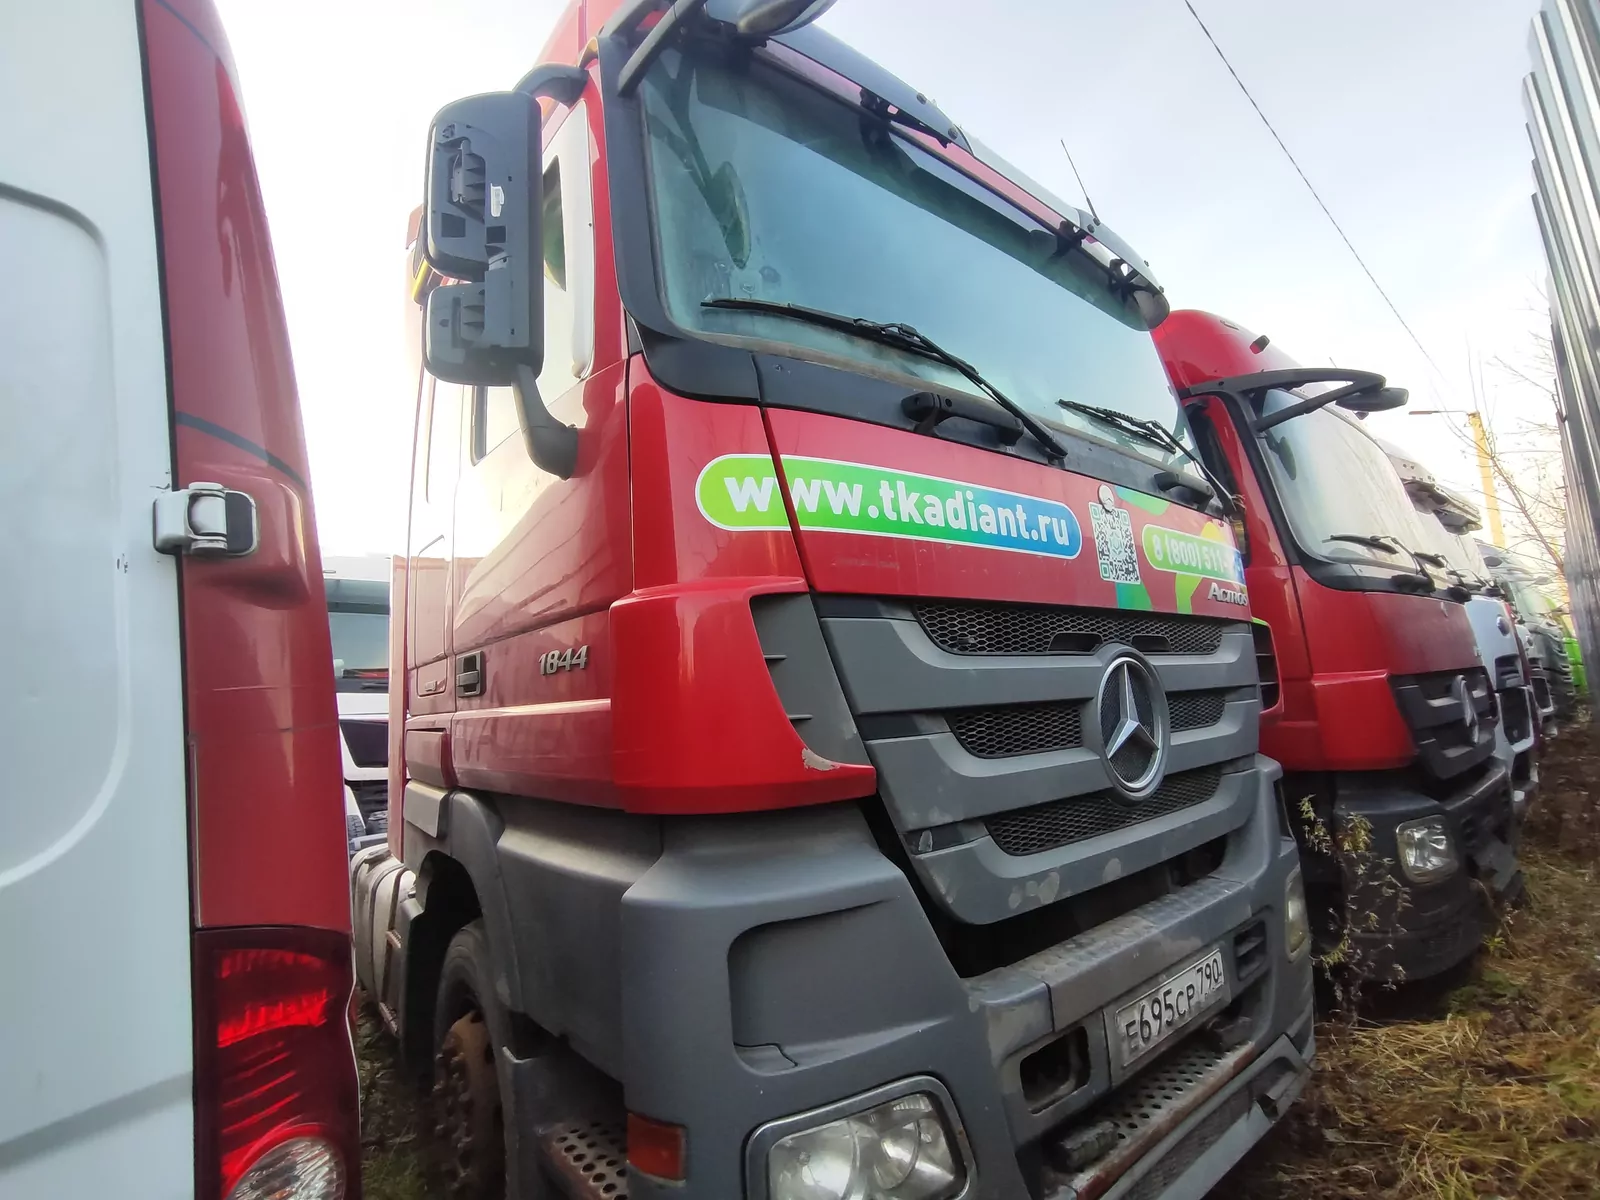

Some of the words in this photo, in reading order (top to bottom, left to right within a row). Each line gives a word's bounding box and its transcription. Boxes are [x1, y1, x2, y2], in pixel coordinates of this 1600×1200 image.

[723, 476, 1070, 546] www.tkadiant.ru
[1152, 533, 1164, 561] 8
[1165, 533, 1201, 571] (800)
[538, 645, 589, 676] 1844
